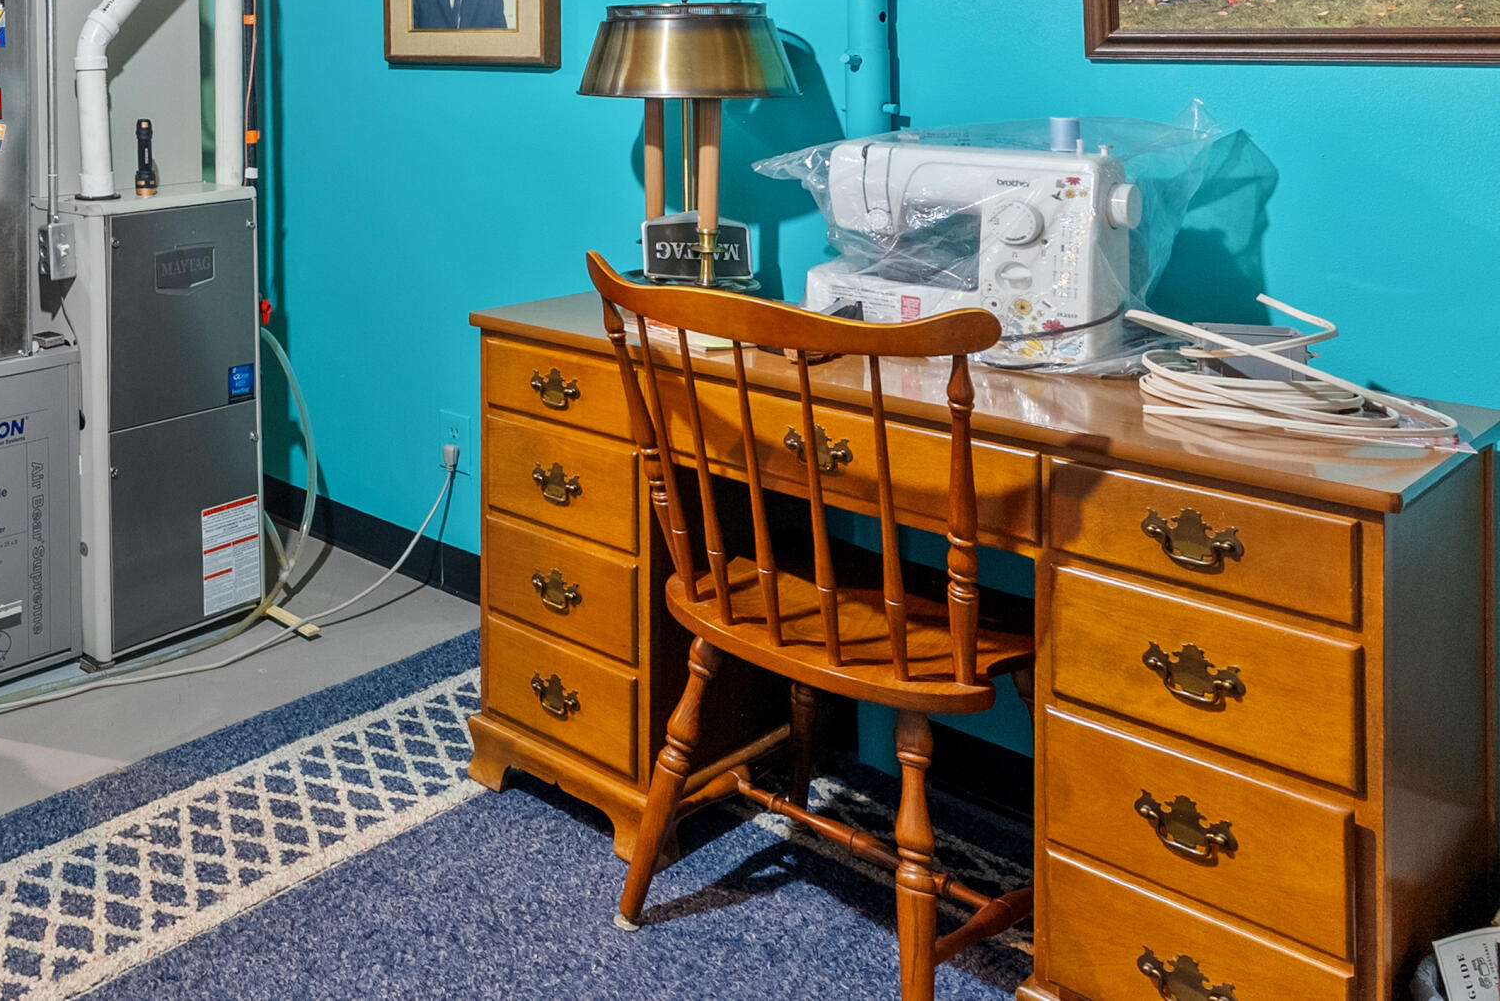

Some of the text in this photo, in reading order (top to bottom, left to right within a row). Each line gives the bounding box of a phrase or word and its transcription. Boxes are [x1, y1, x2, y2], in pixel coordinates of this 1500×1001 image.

[997, 178, 1030, 187] brother
[655, 241, 740, 261] MATAG
[162, 256, 210, 277] MAYTAG
[31, 462, 44, 490] Air
[30, 545, 45, 635] Supreme
[1456, 953, 1477, 1000] GUIDE
